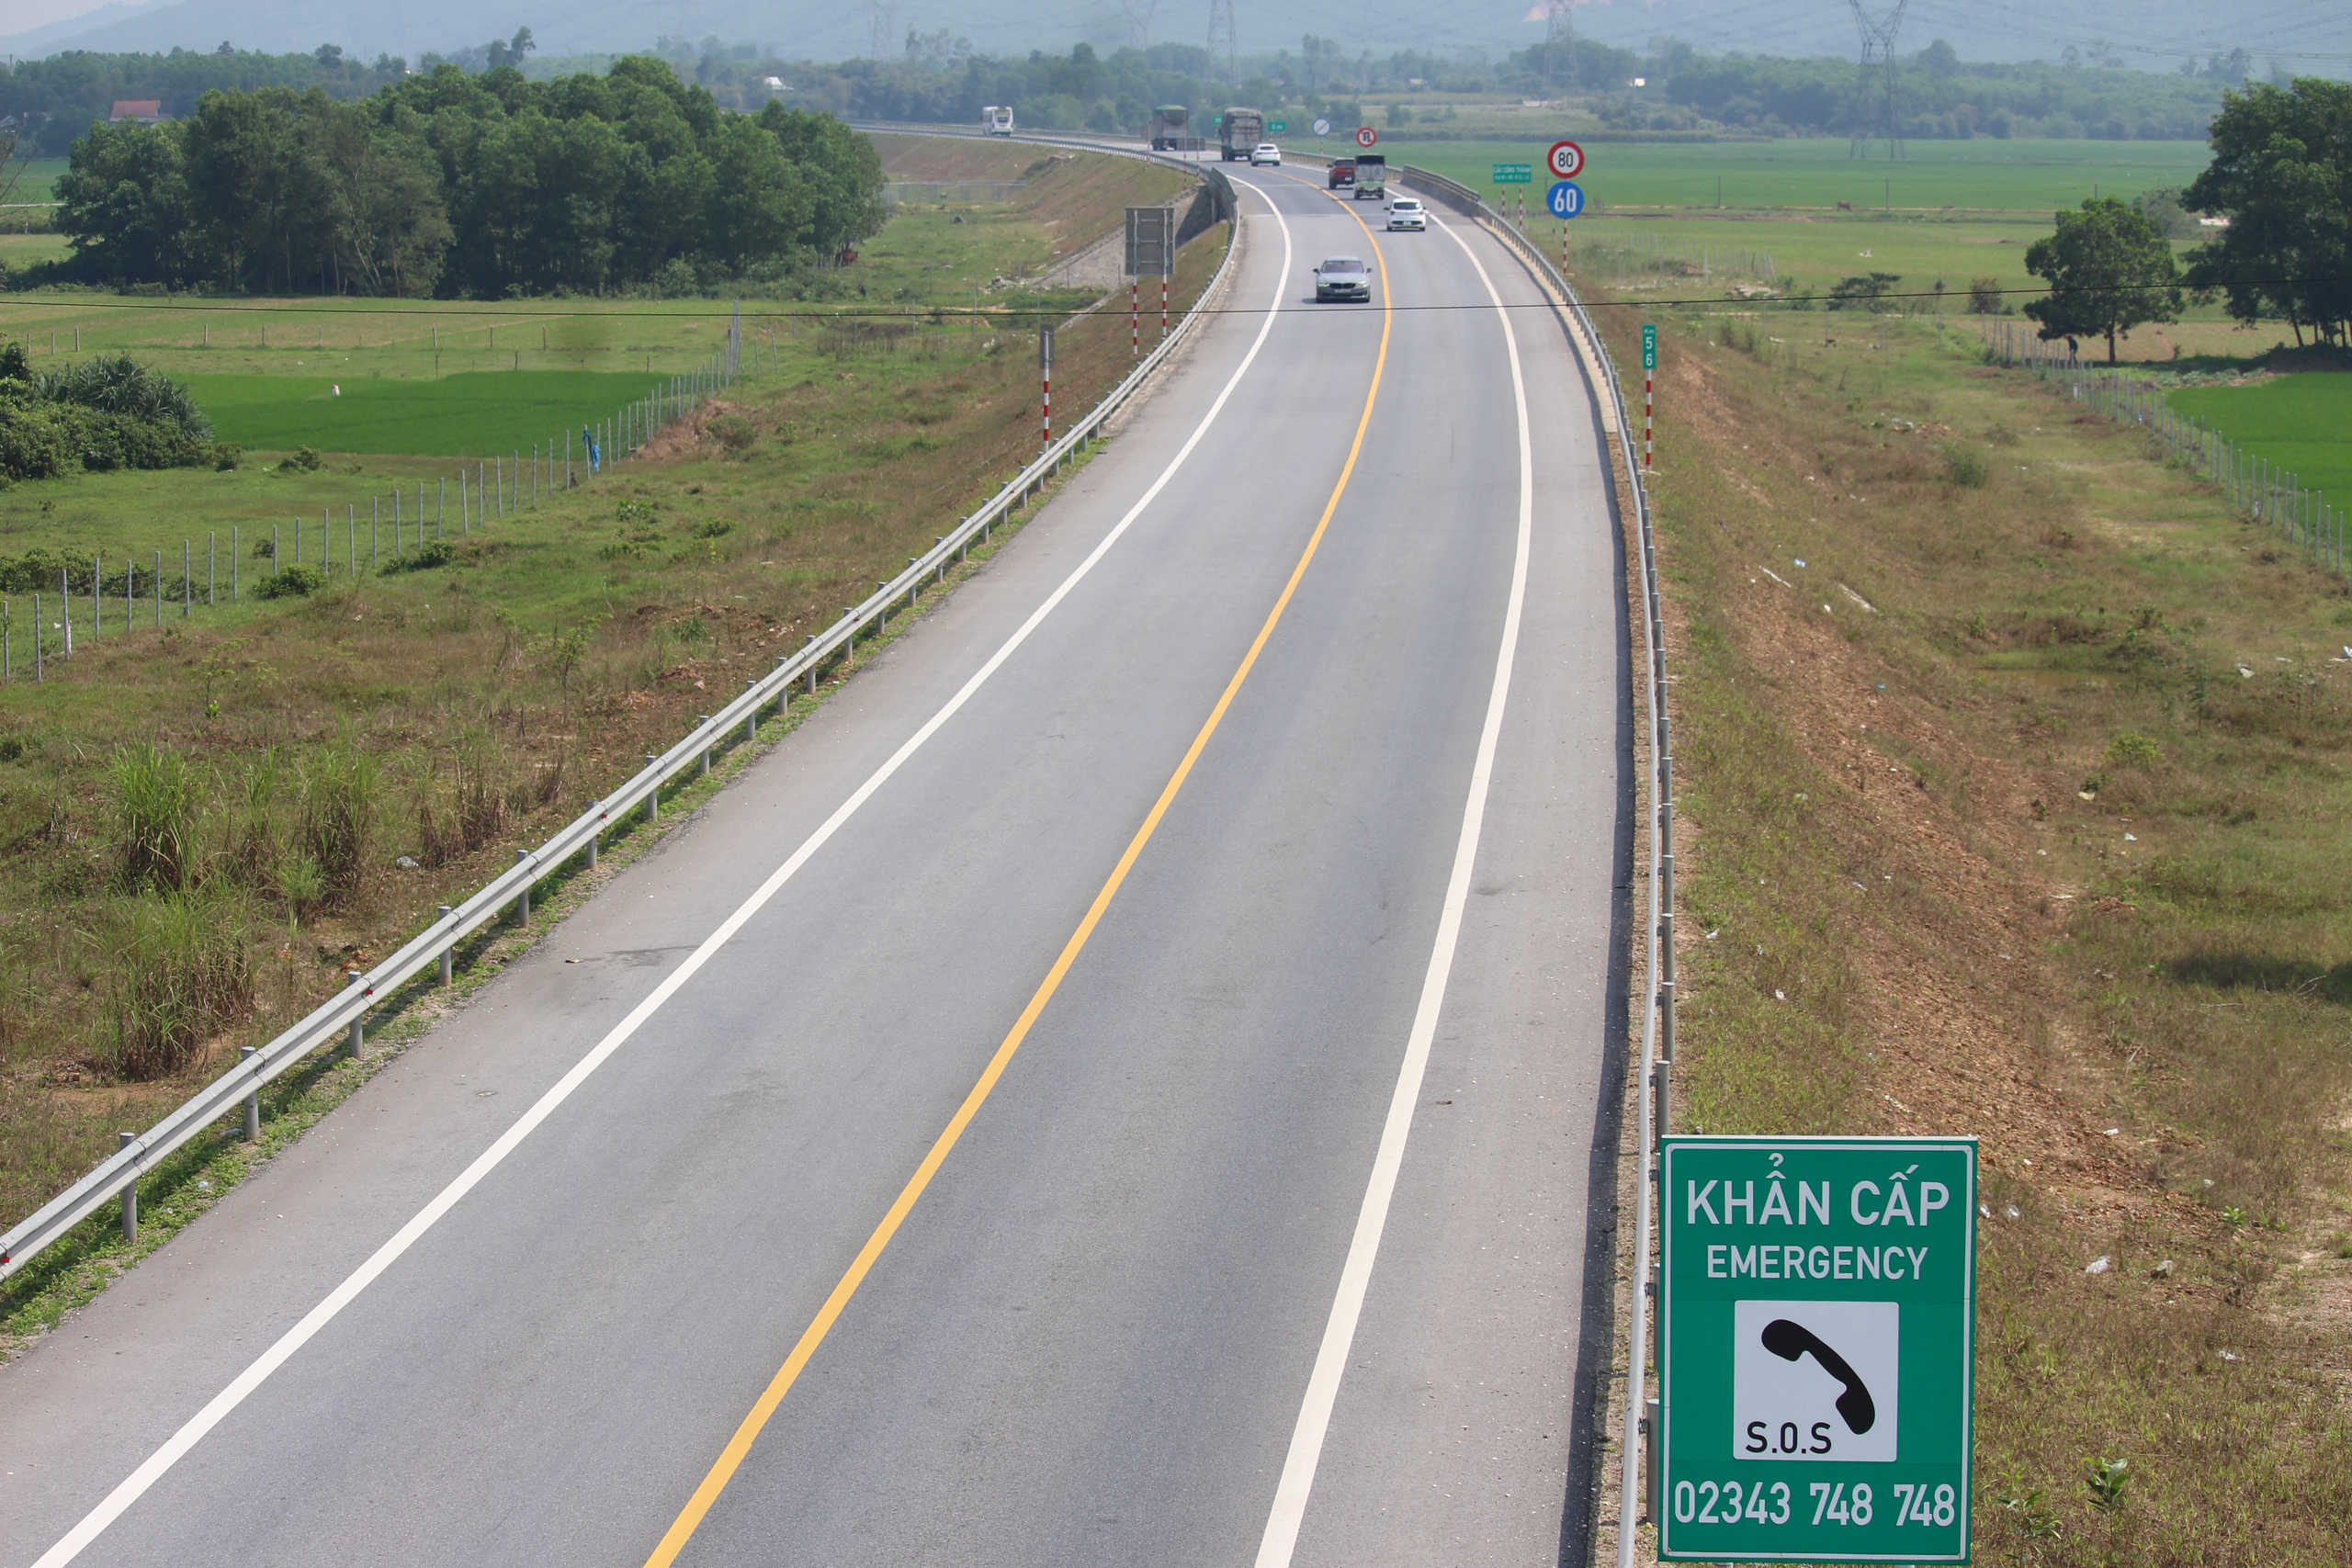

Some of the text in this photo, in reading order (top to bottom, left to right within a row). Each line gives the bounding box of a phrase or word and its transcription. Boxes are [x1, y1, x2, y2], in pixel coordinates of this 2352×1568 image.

[1558, 152, 1573, 167] 80
[1555, 188, 1577, 212] 60
[1688, 1153, 1950, 1226] KHẨN CẤP
[1707, 1245, 1928, 1280] EMERGENCY
[1746, 1421, 1832, 1455] S.O.S
[1675, 1481, 1955, 1527] 02343 748 748
